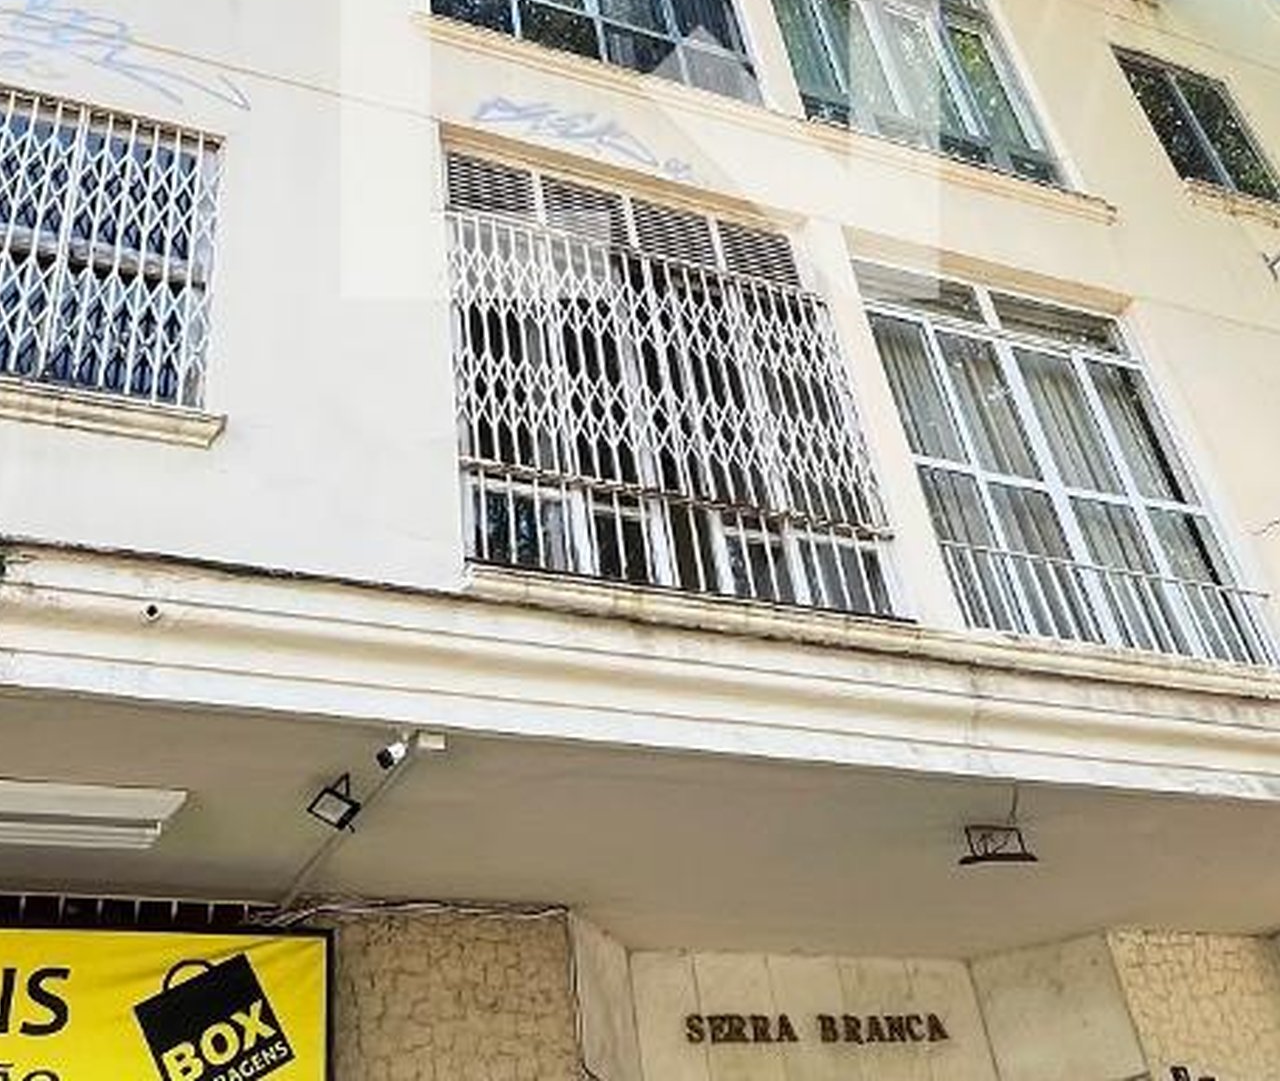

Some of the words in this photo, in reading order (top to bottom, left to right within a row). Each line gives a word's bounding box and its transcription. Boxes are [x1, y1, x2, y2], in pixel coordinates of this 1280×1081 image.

[161, 999, 276, 1081] BOX
[685, 1013, 799, 1045] SERRA
[816, 1013, 950, 1045] BRANCA
